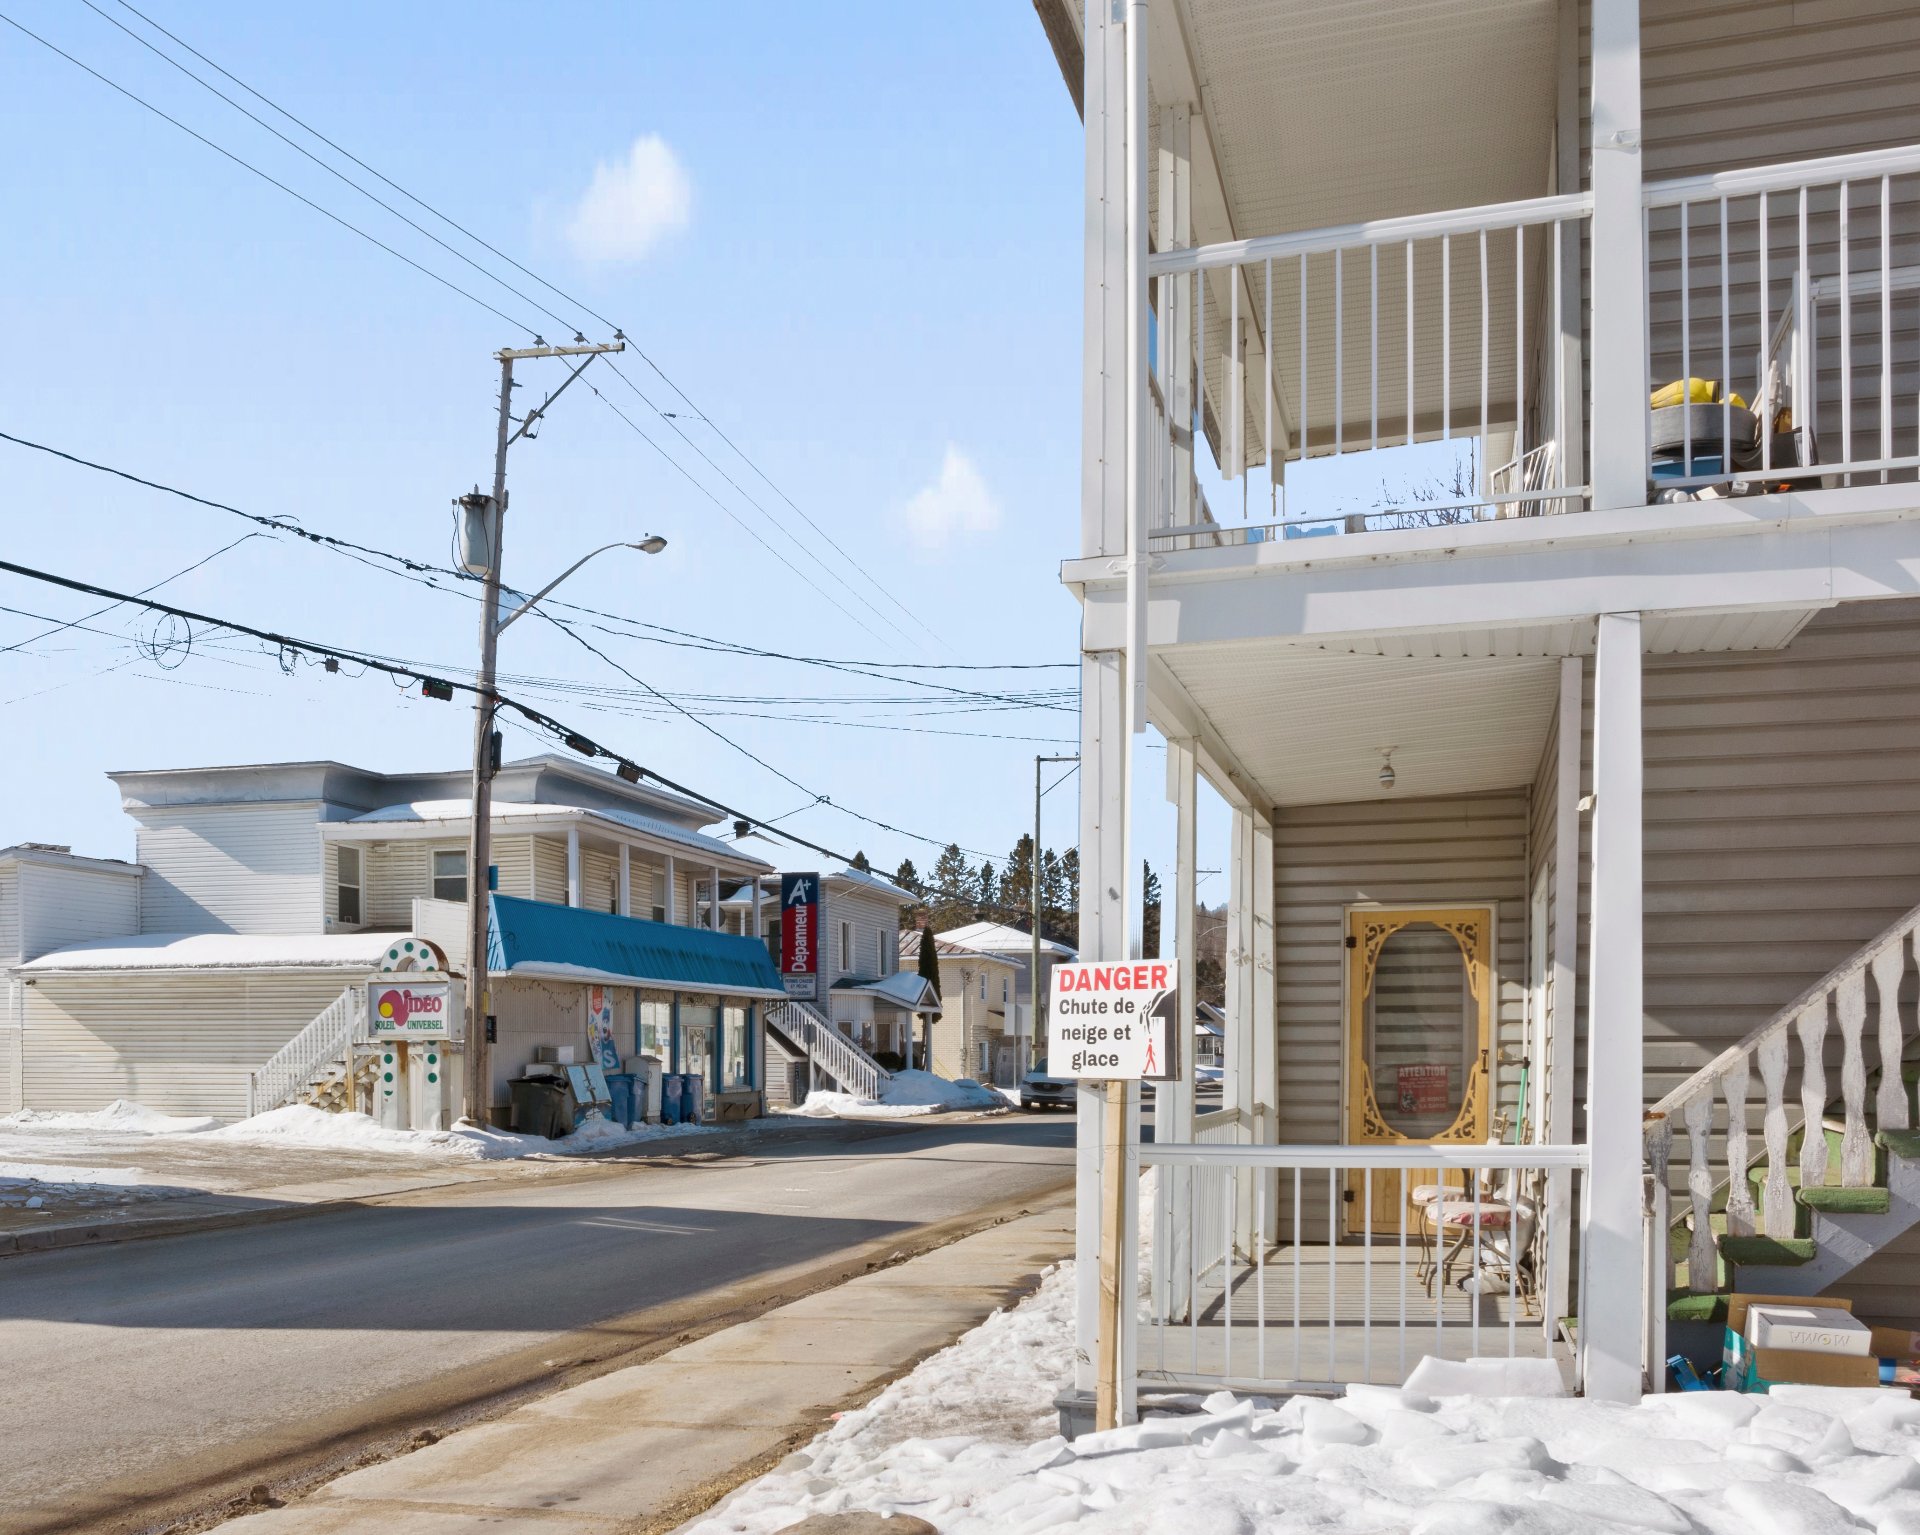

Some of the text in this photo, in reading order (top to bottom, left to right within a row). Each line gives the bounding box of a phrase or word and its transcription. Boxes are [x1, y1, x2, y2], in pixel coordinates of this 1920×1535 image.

[791, 904, 809, 972] Dépanneur
[1059, 965, 1168, 992] DANGER
[378, 989, 442, 1027] VIDÉO
[1059, 997, 1135, 1015] Chute de
[375, 1020, 444, 1030] SOLEIL UNIVERSEL
[1061, 1024, 1132, 1045] neige et
[1071, 1050, 1119, 1071] glace
[1400, 1066, 1446, 1077] ATTENTION
